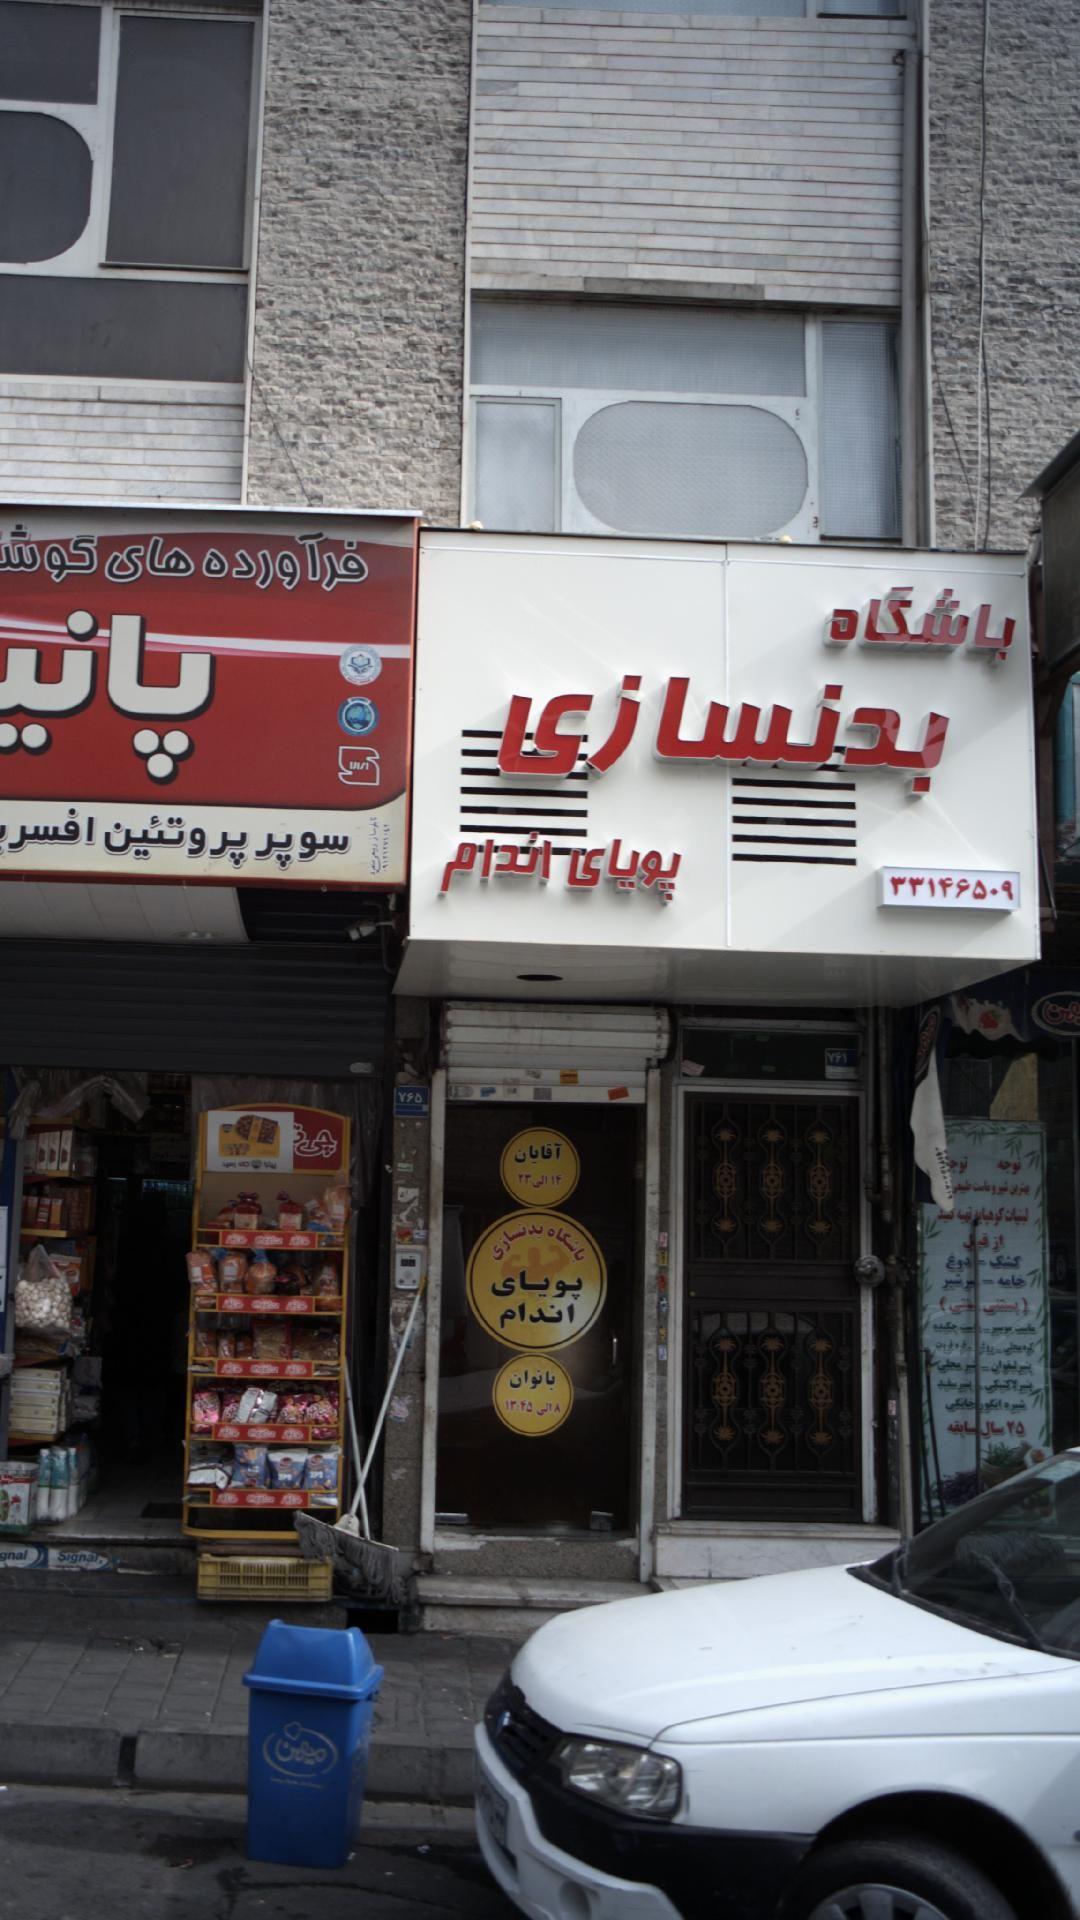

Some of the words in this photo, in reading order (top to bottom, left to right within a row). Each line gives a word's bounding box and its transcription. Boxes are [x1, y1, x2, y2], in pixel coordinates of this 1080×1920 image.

[106, 537, 195, 582] های
[204, 532, 368, 590] فرآورده
[827, 586, 1016, 661] باشگاه
[498, 675, 950, 796] بدنسازی
[104, 815, 248, 868] پروتئین
[254, 828, 350, 870] سوپر
[440, 831, 551, 895] اندام
[567, 838, 682, 904] پویای
[890, 875, 1014, 901] ۳۳۱۴۶۵۰۹
[398, 1092, 423, 1103] ۷۶۵
[514, 1143, 562, 1164] آقایان
[949, 1155, 968, 1174] توج
[532, 1175, 548, 1188] الی
[492, 1223, 544, 1261] بدنسازی
[547, 1227, 585, 1263] باشگاه
[989, 1255, 1022, 1268] کشک
[491, 1269, 583, 1300] پویای
[500, 1302, 575, 1328] اندام
[510, 1370, 555, 1390] بانوان
[537, 1403, 552, 1415] الی
[1007, 1420, 1025, 1435] ۲۵
[57, 1551, 98, 1564] Signal
